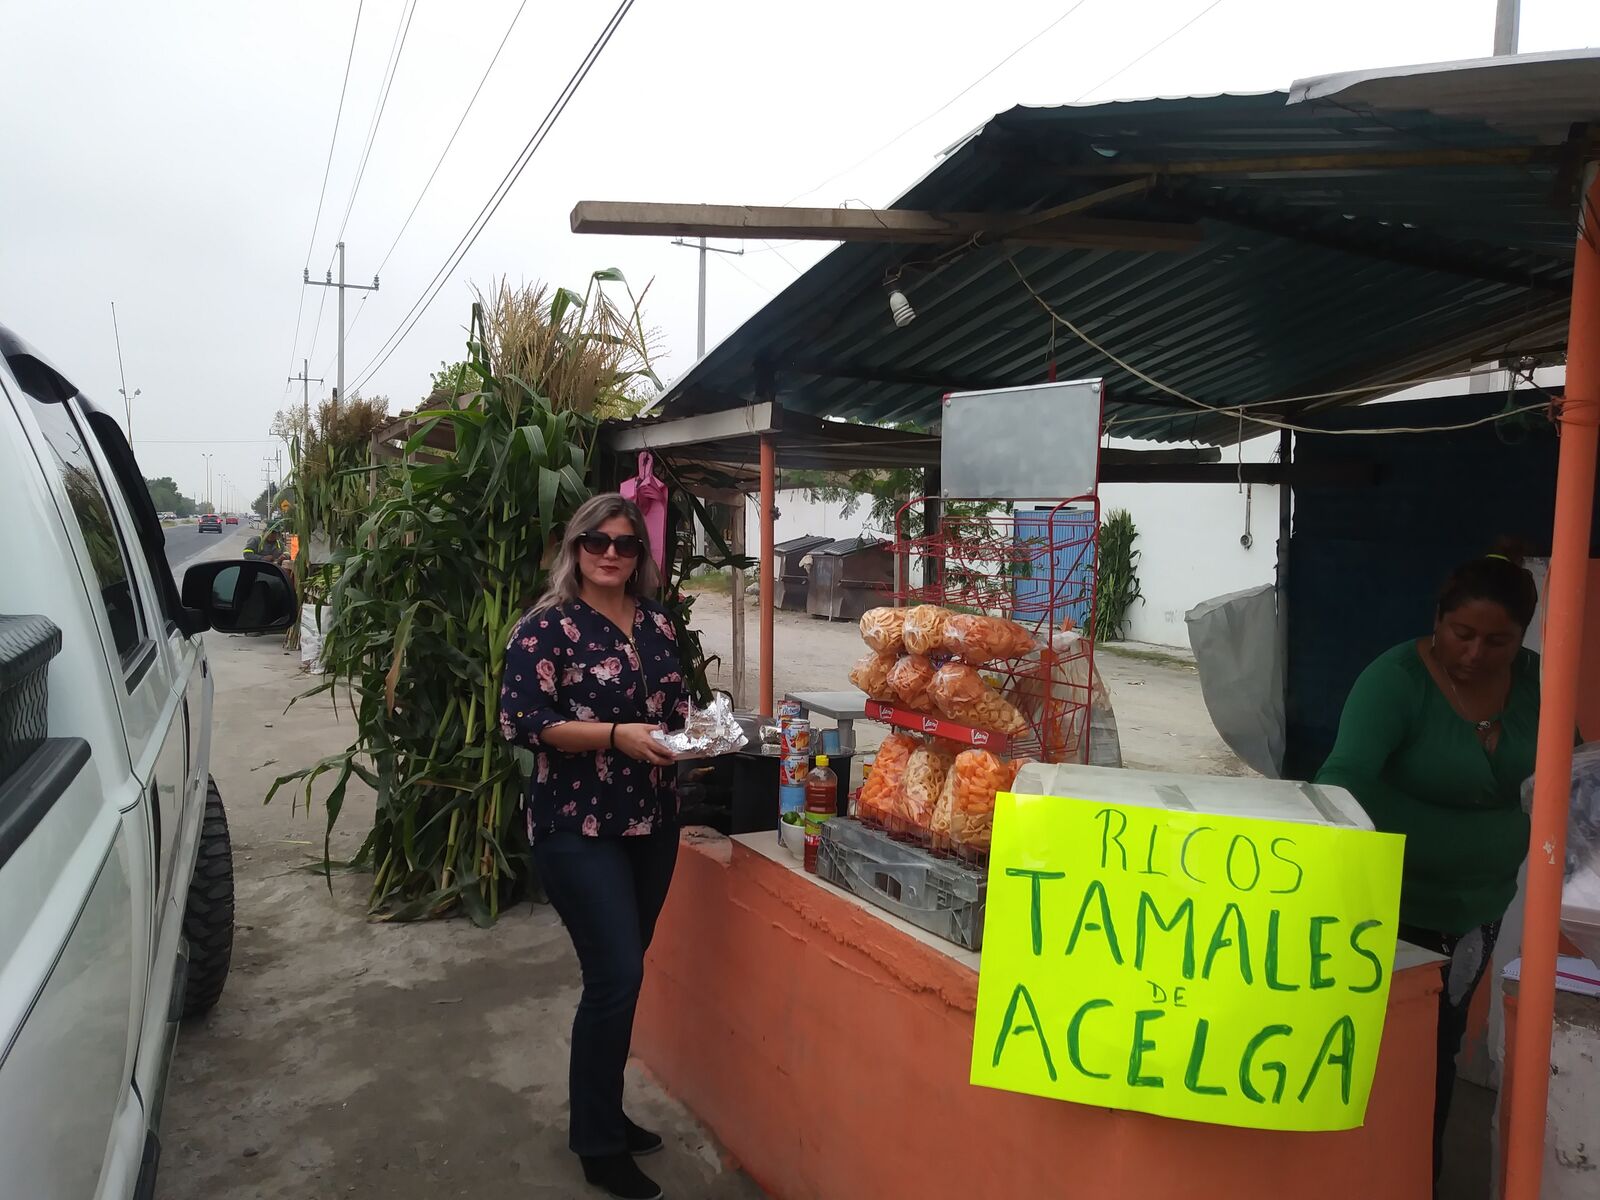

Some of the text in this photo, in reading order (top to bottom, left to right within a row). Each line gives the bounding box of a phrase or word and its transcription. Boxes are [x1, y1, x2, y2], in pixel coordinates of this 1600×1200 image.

[1095, 809, 1303, 893] RICOS
[1005, 867, 1384, 994] TAMALES
[992, 983, 1356, 1106] ACELGA
[1147, 980, 1188, 1007] DE
